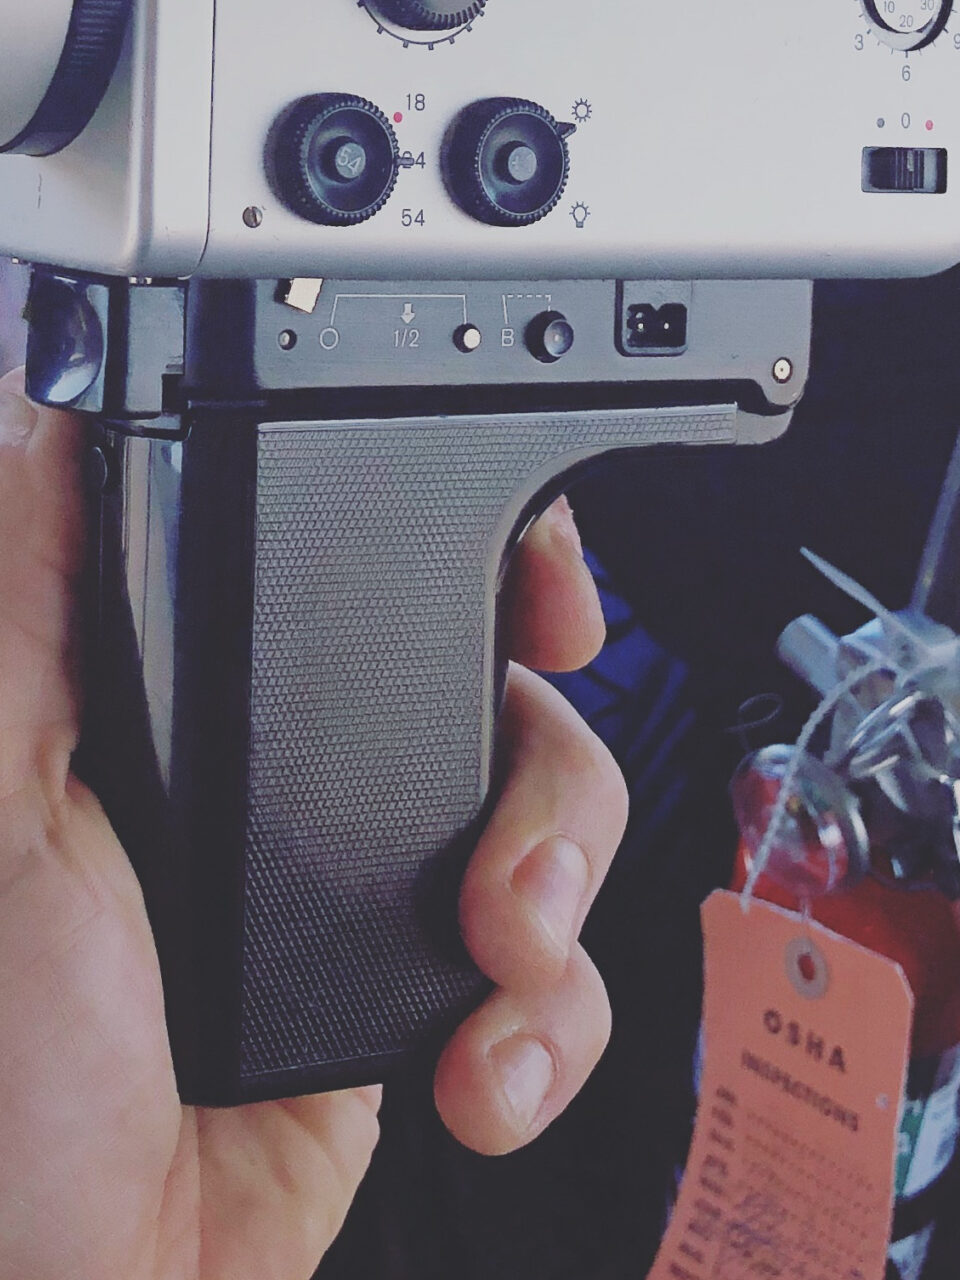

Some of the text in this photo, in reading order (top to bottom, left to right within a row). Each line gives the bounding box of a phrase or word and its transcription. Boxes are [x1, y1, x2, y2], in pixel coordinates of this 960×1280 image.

[883, 0, 895, 13] 10
[899, 15, 914, 28] 20
[854, 34, 865, 51] 3
[901, 65, 912, 82] 6
[405, 93, 426, 112] 18
[900, 112, 911, 129] 0
[337, 146, 362, 176] 54
[400, 208, 426, 227] 54
[392, 329, 420, 349] 1/2
[500, 328, 516, 348] B
[762, 1008, 847, 1073] OSHA
